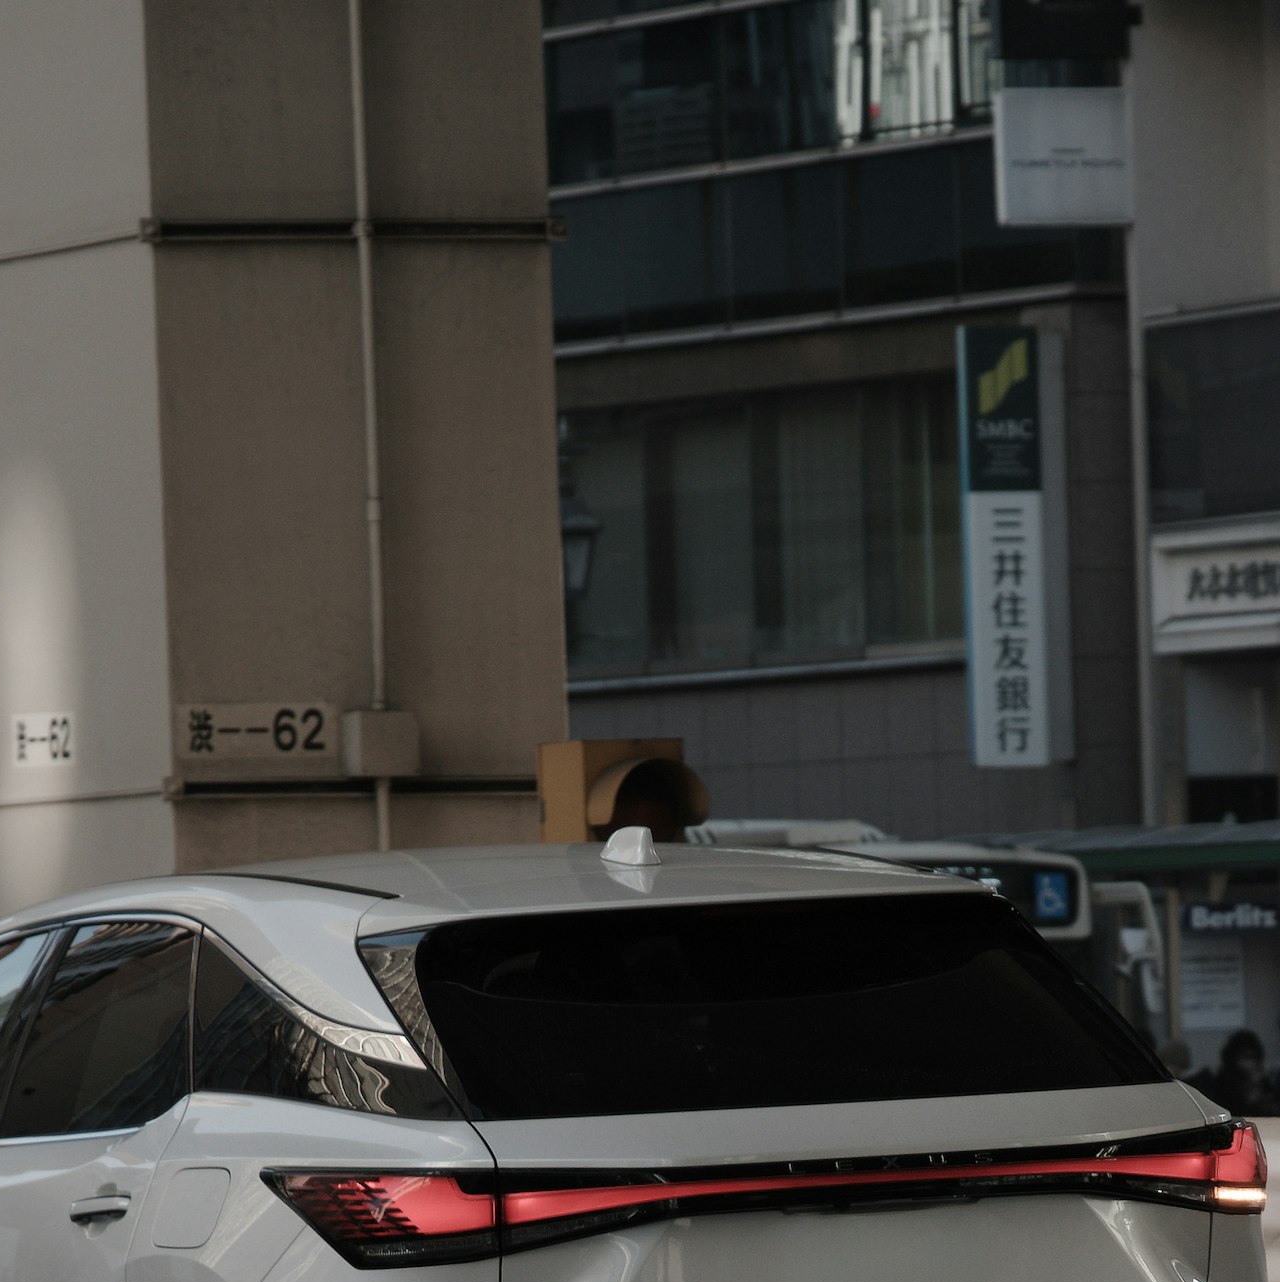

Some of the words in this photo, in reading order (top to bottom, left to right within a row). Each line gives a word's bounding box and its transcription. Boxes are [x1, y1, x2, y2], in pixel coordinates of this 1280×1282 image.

[976, 418, 1034, 440] SMBC
[990, 507, 1032, 755] 三井住友銀行
[1190, 903, 1278, 929] Berlitz
[787, 1152, 995, 1174] LEXUS
